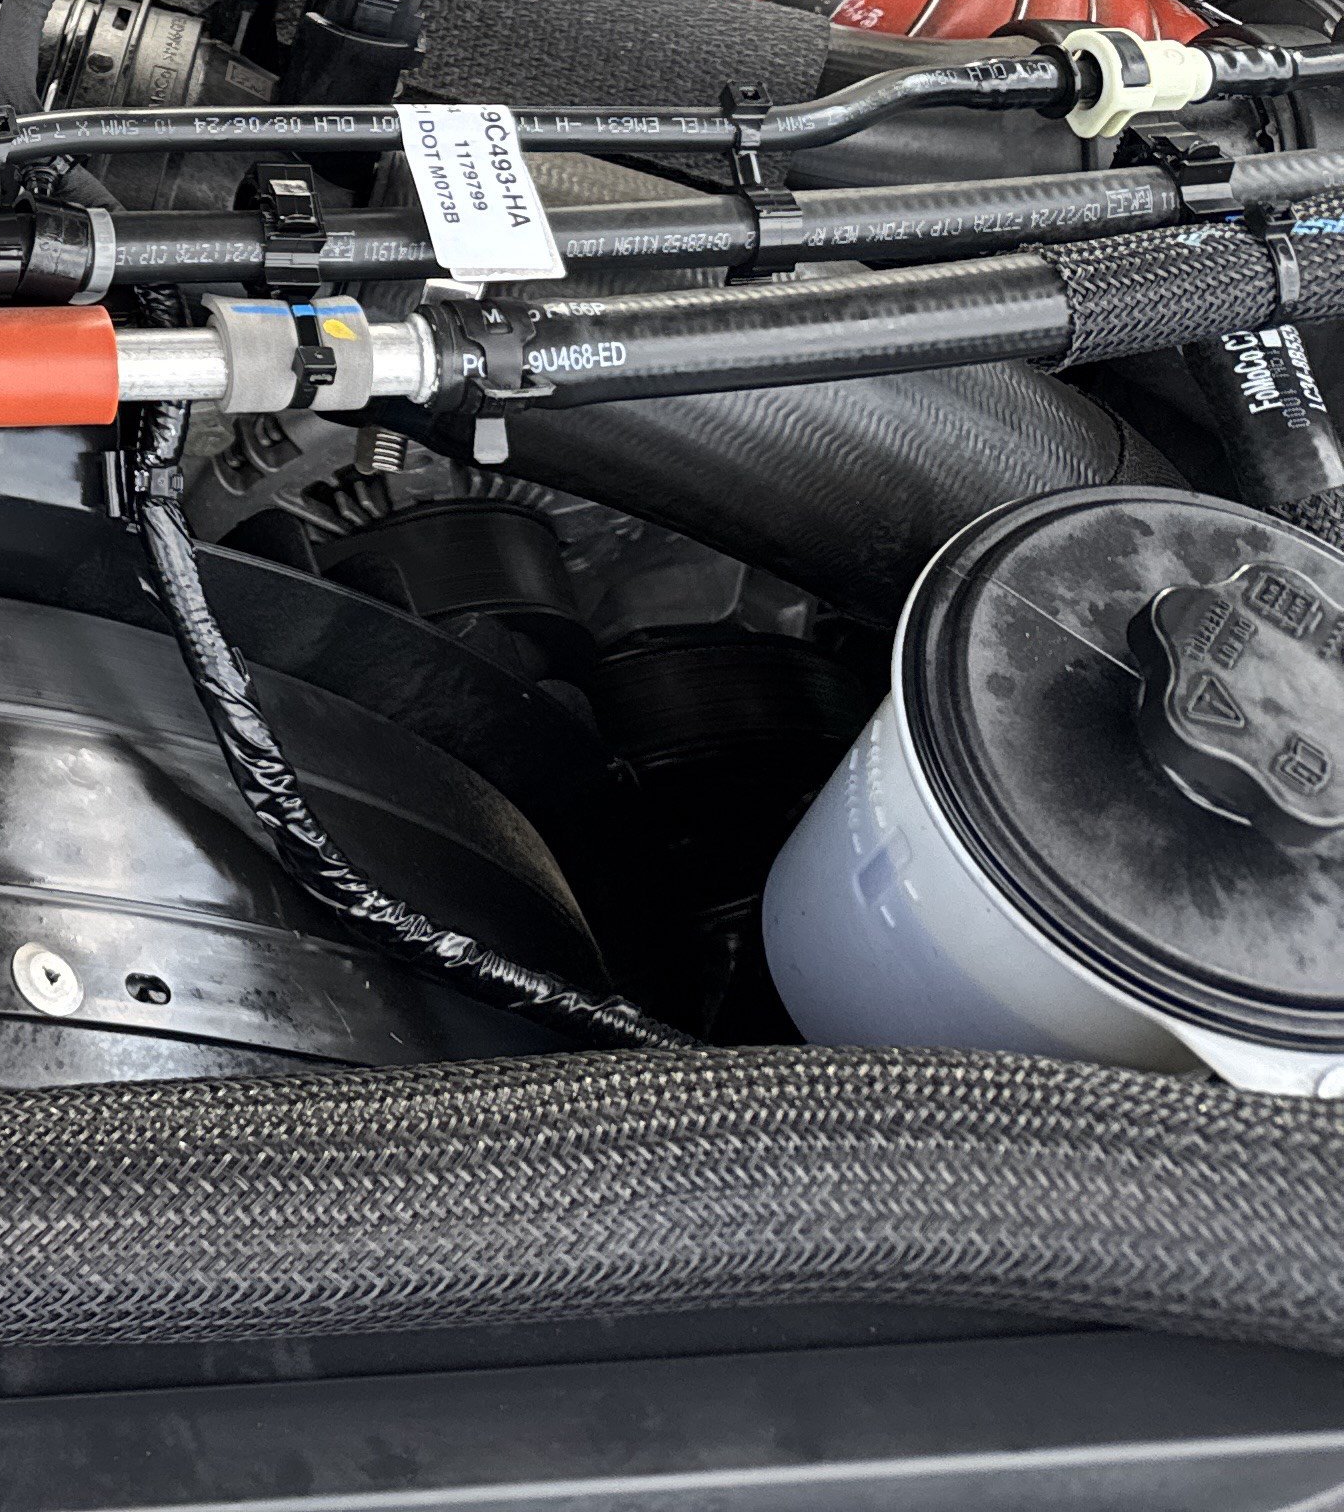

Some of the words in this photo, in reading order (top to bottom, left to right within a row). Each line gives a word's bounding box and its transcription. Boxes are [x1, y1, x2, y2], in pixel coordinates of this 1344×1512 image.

[75, 120, 90, 138] X
[100, 118, 175, 136] 10.5MM
[193, 115, 301, 135] 08/06/24
[313, 115, 355, 134] DLH
[418, 120, 442, 161] DOT
[454, 140, 489, 211] 1179799
[428, 165, 461, 224] M073B
[566, 237, 605, 258] 1000
[1233, 349, 1286, 414] FoMoCo
